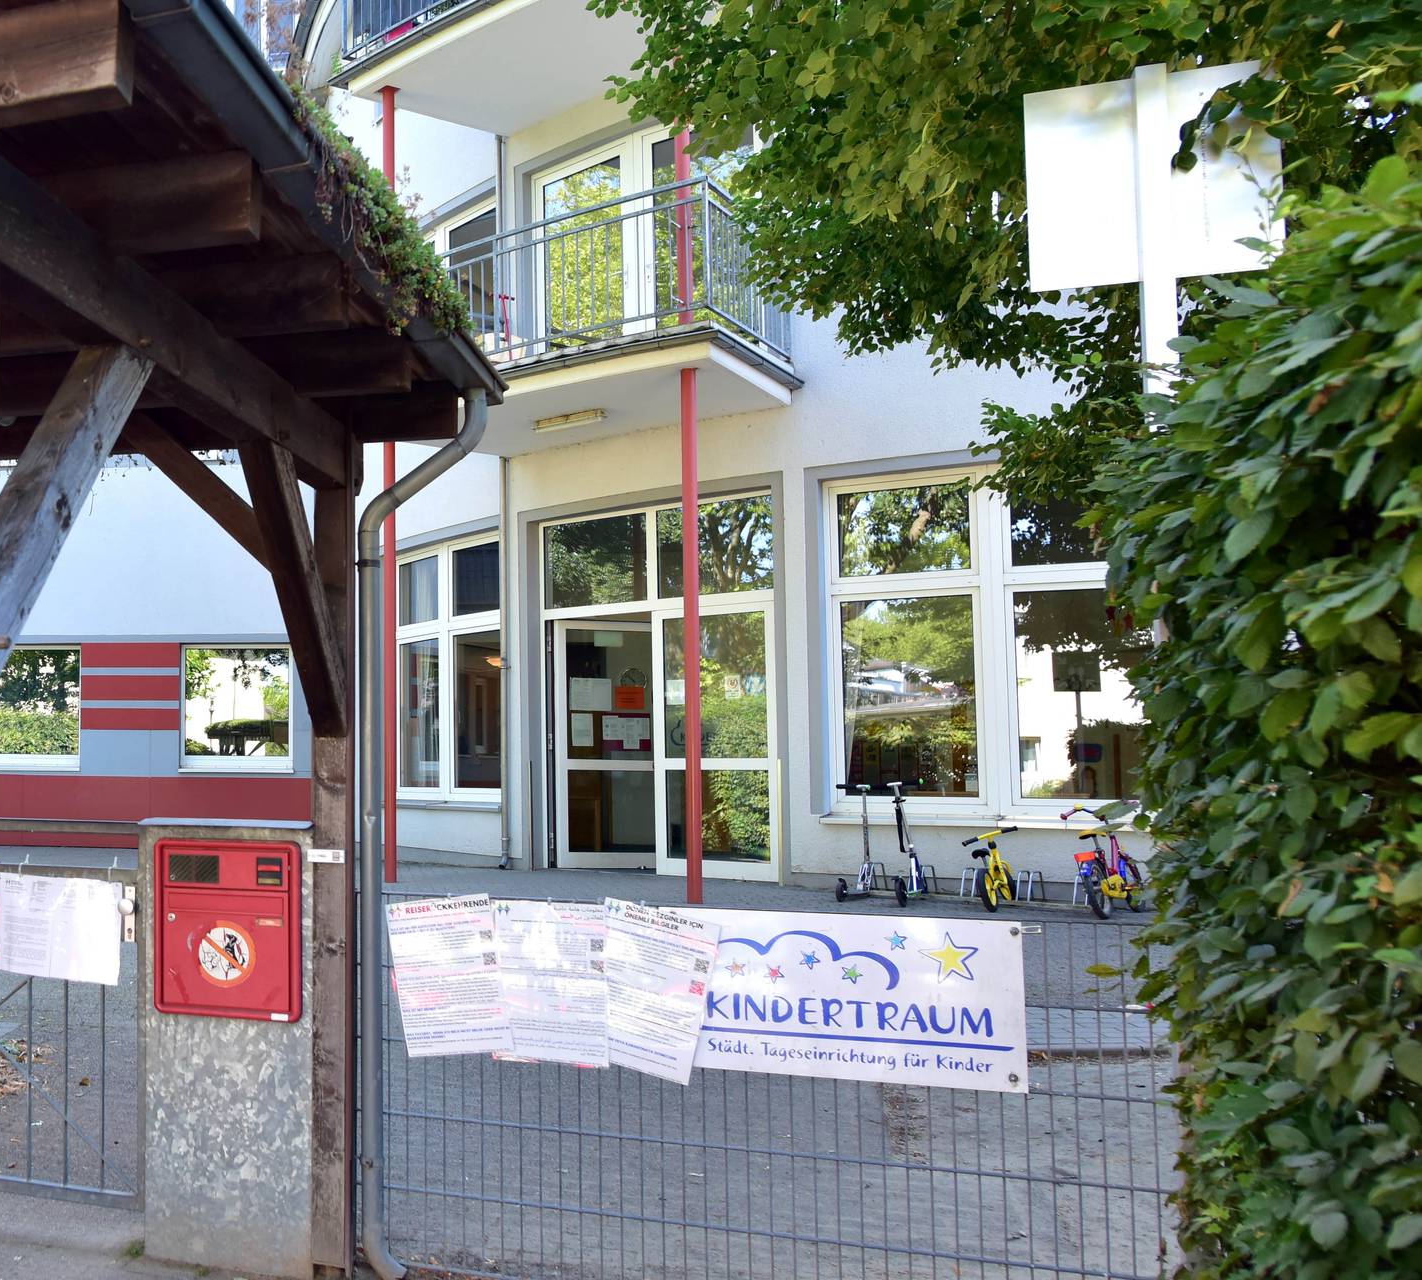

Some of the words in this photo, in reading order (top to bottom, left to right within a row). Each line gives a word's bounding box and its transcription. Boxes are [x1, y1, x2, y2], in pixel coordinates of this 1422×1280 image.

[706, 990, 994, 1038] KINDERTRAUM
[708, 1037, 754, 1055] Städt.
[760, 1041, 897, 1070] Tageseinrichtung
[904, 1052, 929, 1068] für
[936, 1054, 994, 1073] Kinder
